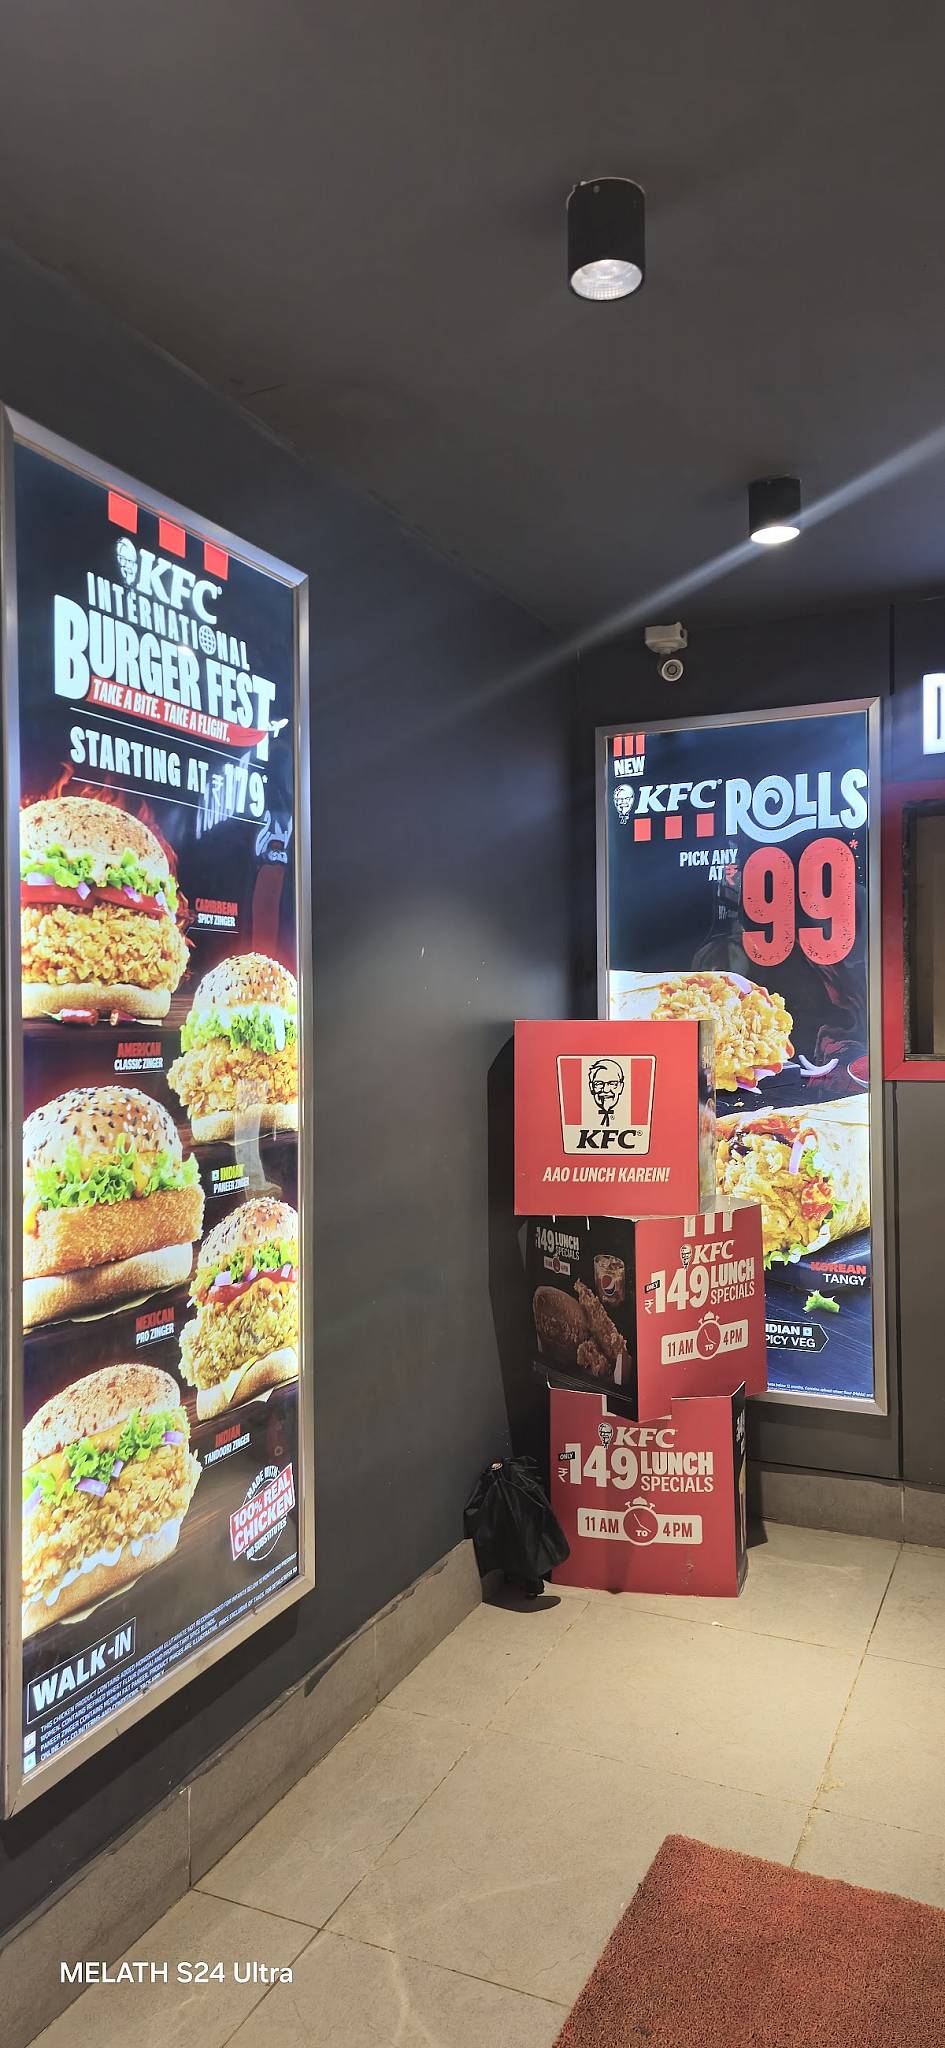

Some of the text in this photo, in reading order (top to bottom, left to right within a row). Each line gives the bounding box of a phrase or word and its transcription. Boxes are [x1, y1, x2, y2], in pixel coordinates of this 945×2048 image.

[54, 594, 276, 762] BURGER FEST
[93, 678, 230, 743] TAKE A BITE. TAKE A FLIGHT.
[70, 724, 181, 787] STARTING
[187, 757, 209, 794] AT
[614, 755, 645, 776] NEW
[726, 768, 868, 843] ROLLS
[680, 848, 738, 867] PICK ANY
[708, 865, 724, 881] AT
[197, 913, 236, 927] SPICY ZINGER
[117, 1042, 162, 1058] AMERICAN
[114, 1057, 164, 1071] CLASSIC ZINGER
[543, 1166, 671, 1182] AAO LUNCH KAREIN!
[213, 1180, 235, 1194] PANEER
[555, 1231, 579, 1250] LUNCH
[556, 1246, 580, 1260] SPECIALS
[691, 1239, 735, 1265] KFC
[710, 1257, 754, 1289] LUNCH
[809, 1261, 867, 1275] KOREAN
[823, 1273, 867, 1286] TANGY
[710, 1281, 755, 1305] SPECIALS
[135, 1307, 175, 1331] MEXICAN
[136, 1323, 175, 1344] PRO ZINGER
[765, 1335, 815, 1348] PICY VEG
[667, 1342, 676, 1357] 11
[679, 1338, 693, 1355] AM
[613, 1426, 676, 1448] KFC
[204, 1432, 250, 1465] TANDOORI ZINGER
[640, 1451, 713, 1475] LUNCH
[247, 1465, 279, 1499] MADE WITH
[640, 1476, 714, 1492] SPECIALS
[233, 1472, 290, 1529] 100% REAL
[234, 1487, 293, 1552] CHICKEN
[585, 1516, 596, 1531] 11
[599, 1518, 619, 1534] AM
[635, 1529, 648, 1537] TO
[32, 1626, 132, 1712] WALK-IN
[40, 1719, 52, 1733] THIS
